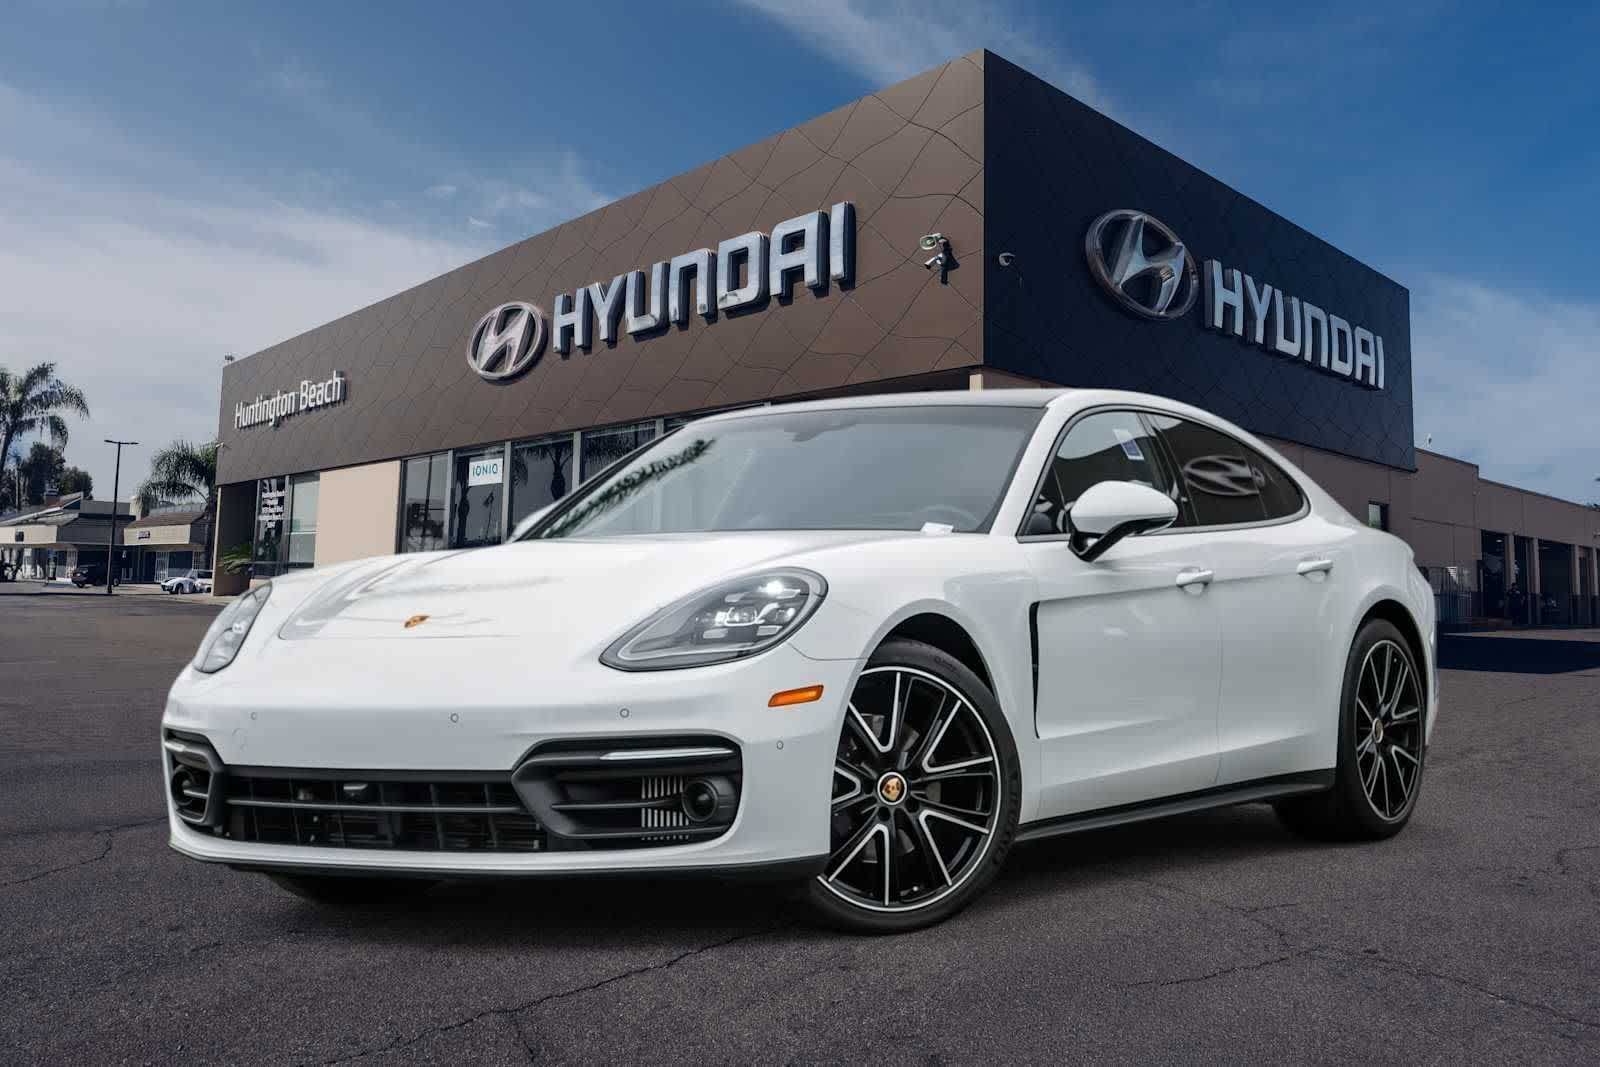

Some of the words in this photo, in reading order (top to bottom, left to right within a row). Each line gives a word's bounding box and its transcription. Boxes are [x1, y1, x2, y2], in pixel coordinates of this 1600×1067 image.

[553, 201, 854, 356] HYUNDAI
[1206, 259, 1385, 390] HYUNDAI
[234, 390, 298, 429] Huntington
[299, 370, 344, 411] Beach
